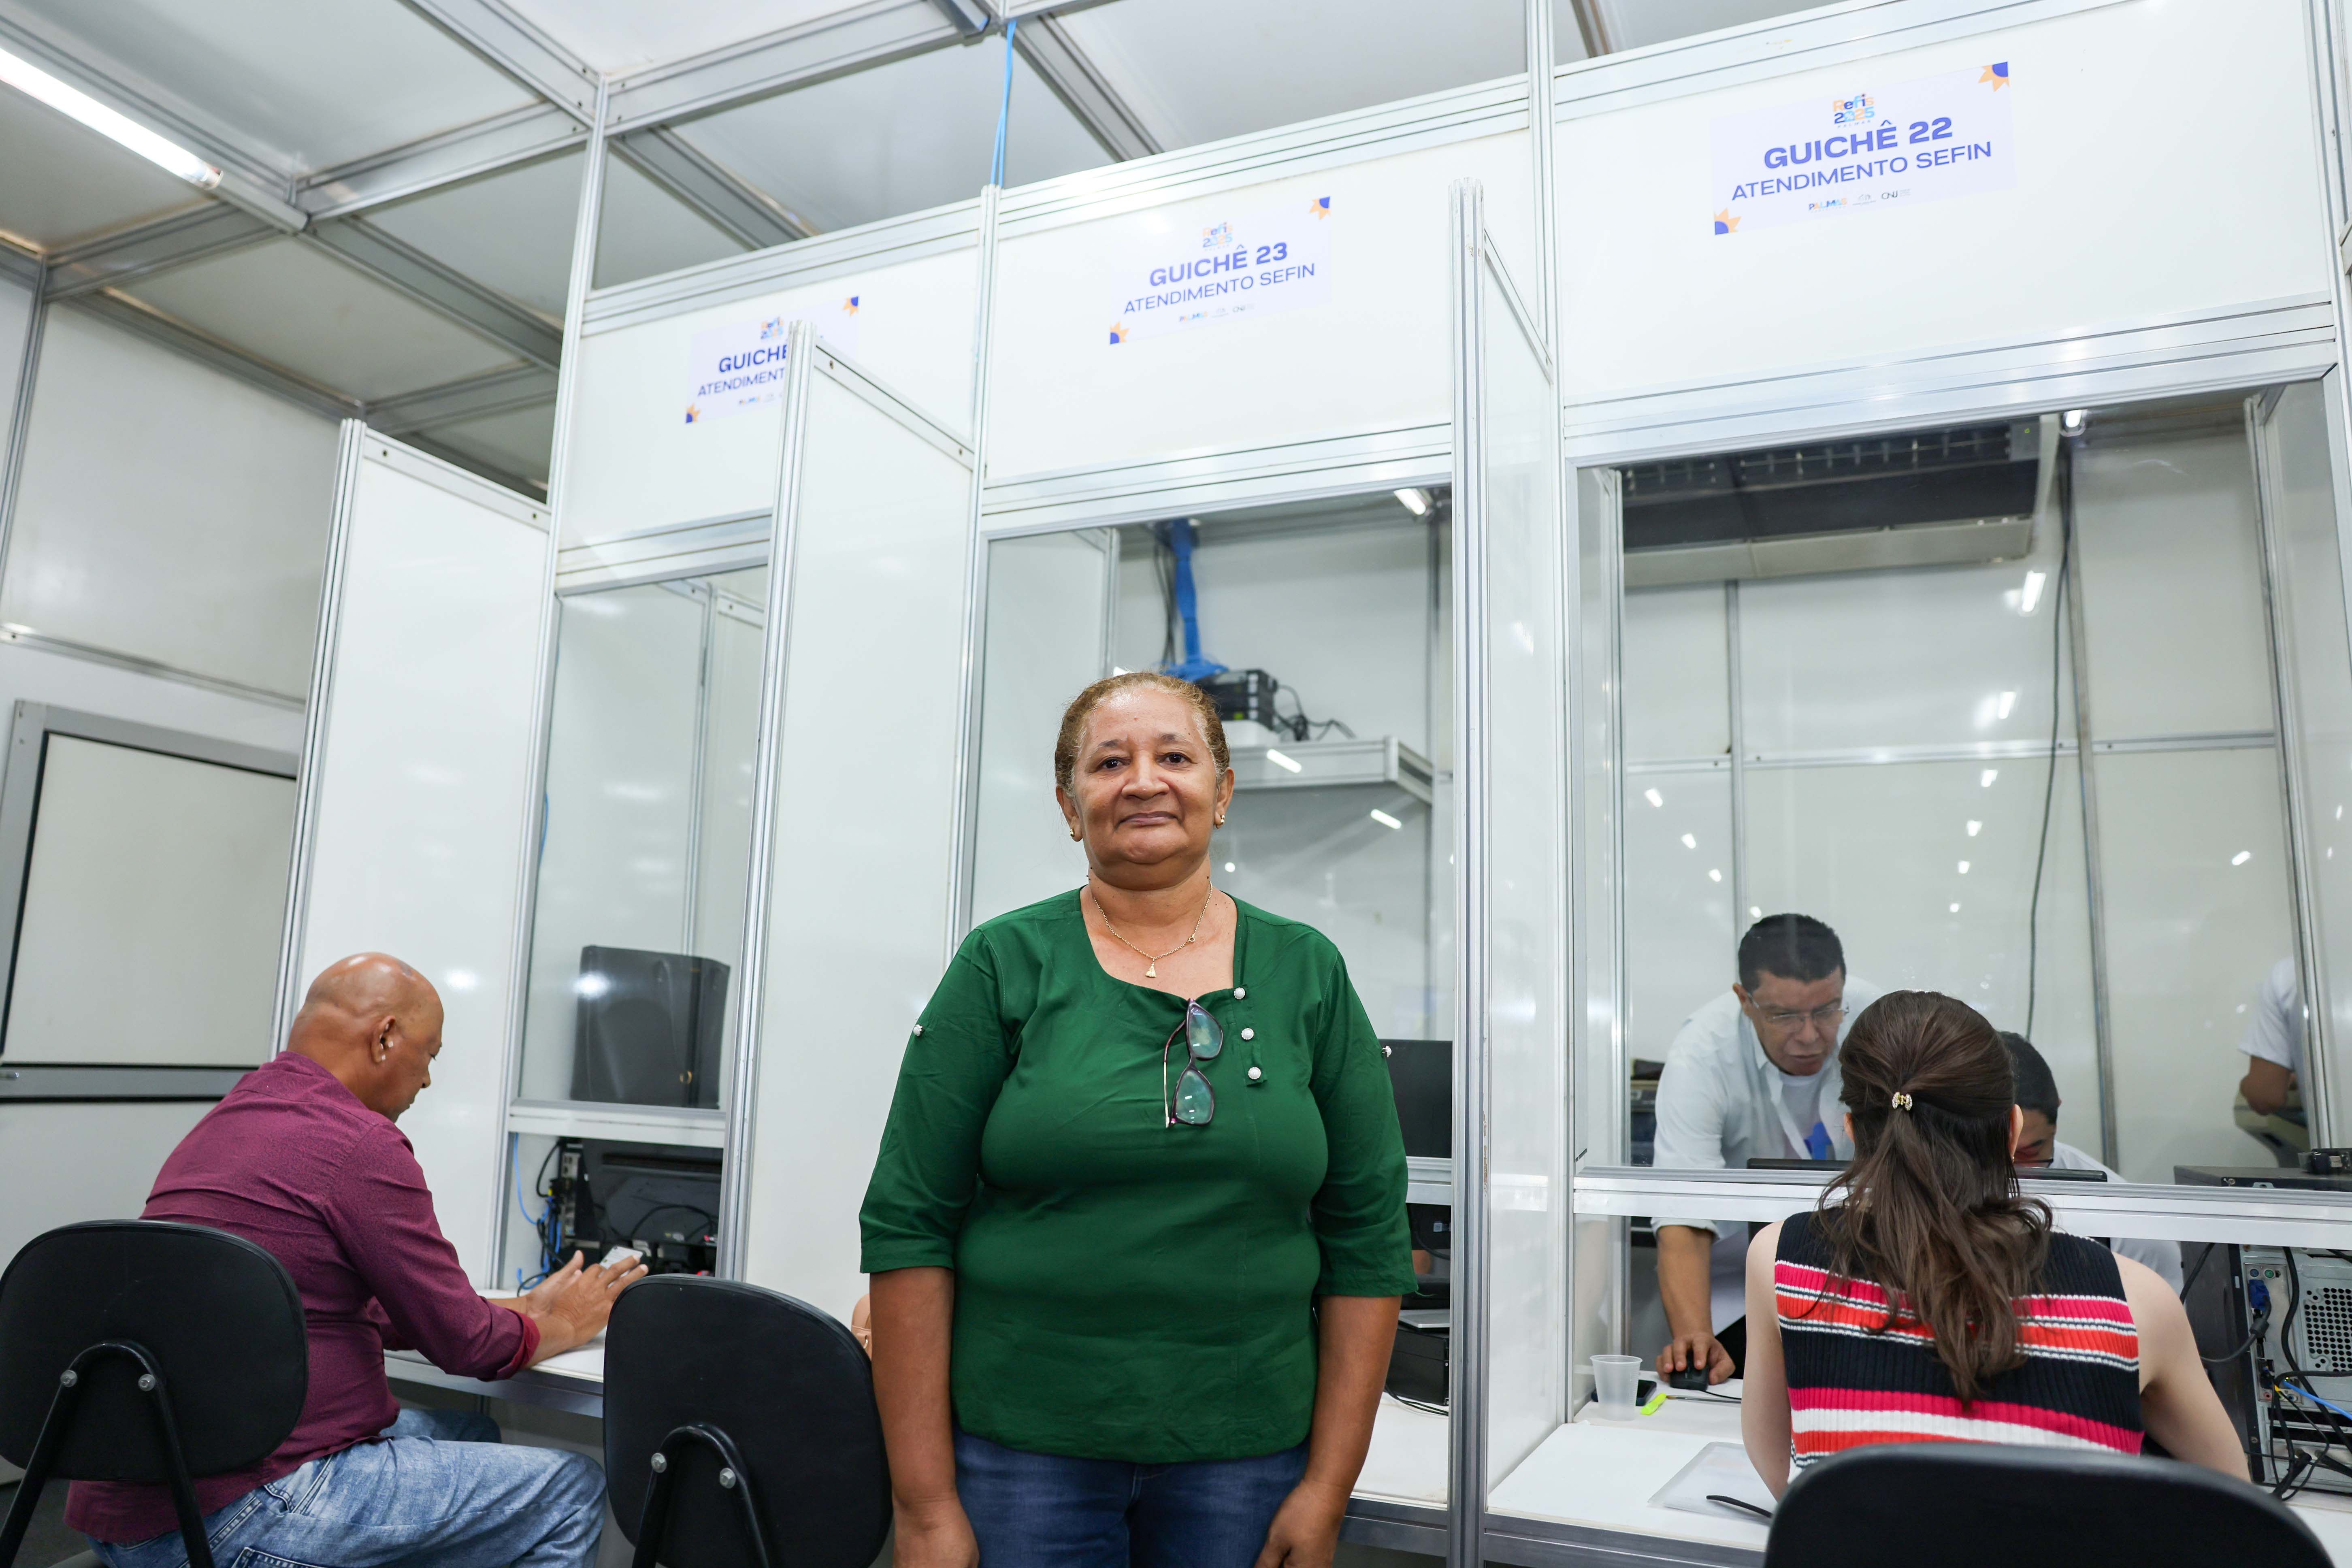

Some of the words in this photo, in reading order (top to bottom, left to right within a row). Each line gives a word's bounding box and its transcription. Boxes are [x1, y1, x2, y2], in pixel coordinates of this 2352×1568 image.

[1833, 93, 1875, 112] Refis
[1764, 119, 1898, 169] GUICHÊ
[1909, 116, 1953, 145] 22
[1731, 156, 1909, 201] ATENDIMENTO
[1916, 141, 1992, 169] SEFIN
[1124, 276, 1254, 314] ATENDIMENTO
[1259, 262, 1315, 286] SEFIN
[1149, 244, 1248, 287] GUICHÊ
[1256, 241, 1288, 266] 23
[697, 366, 785, 397] ATENDIMENT
